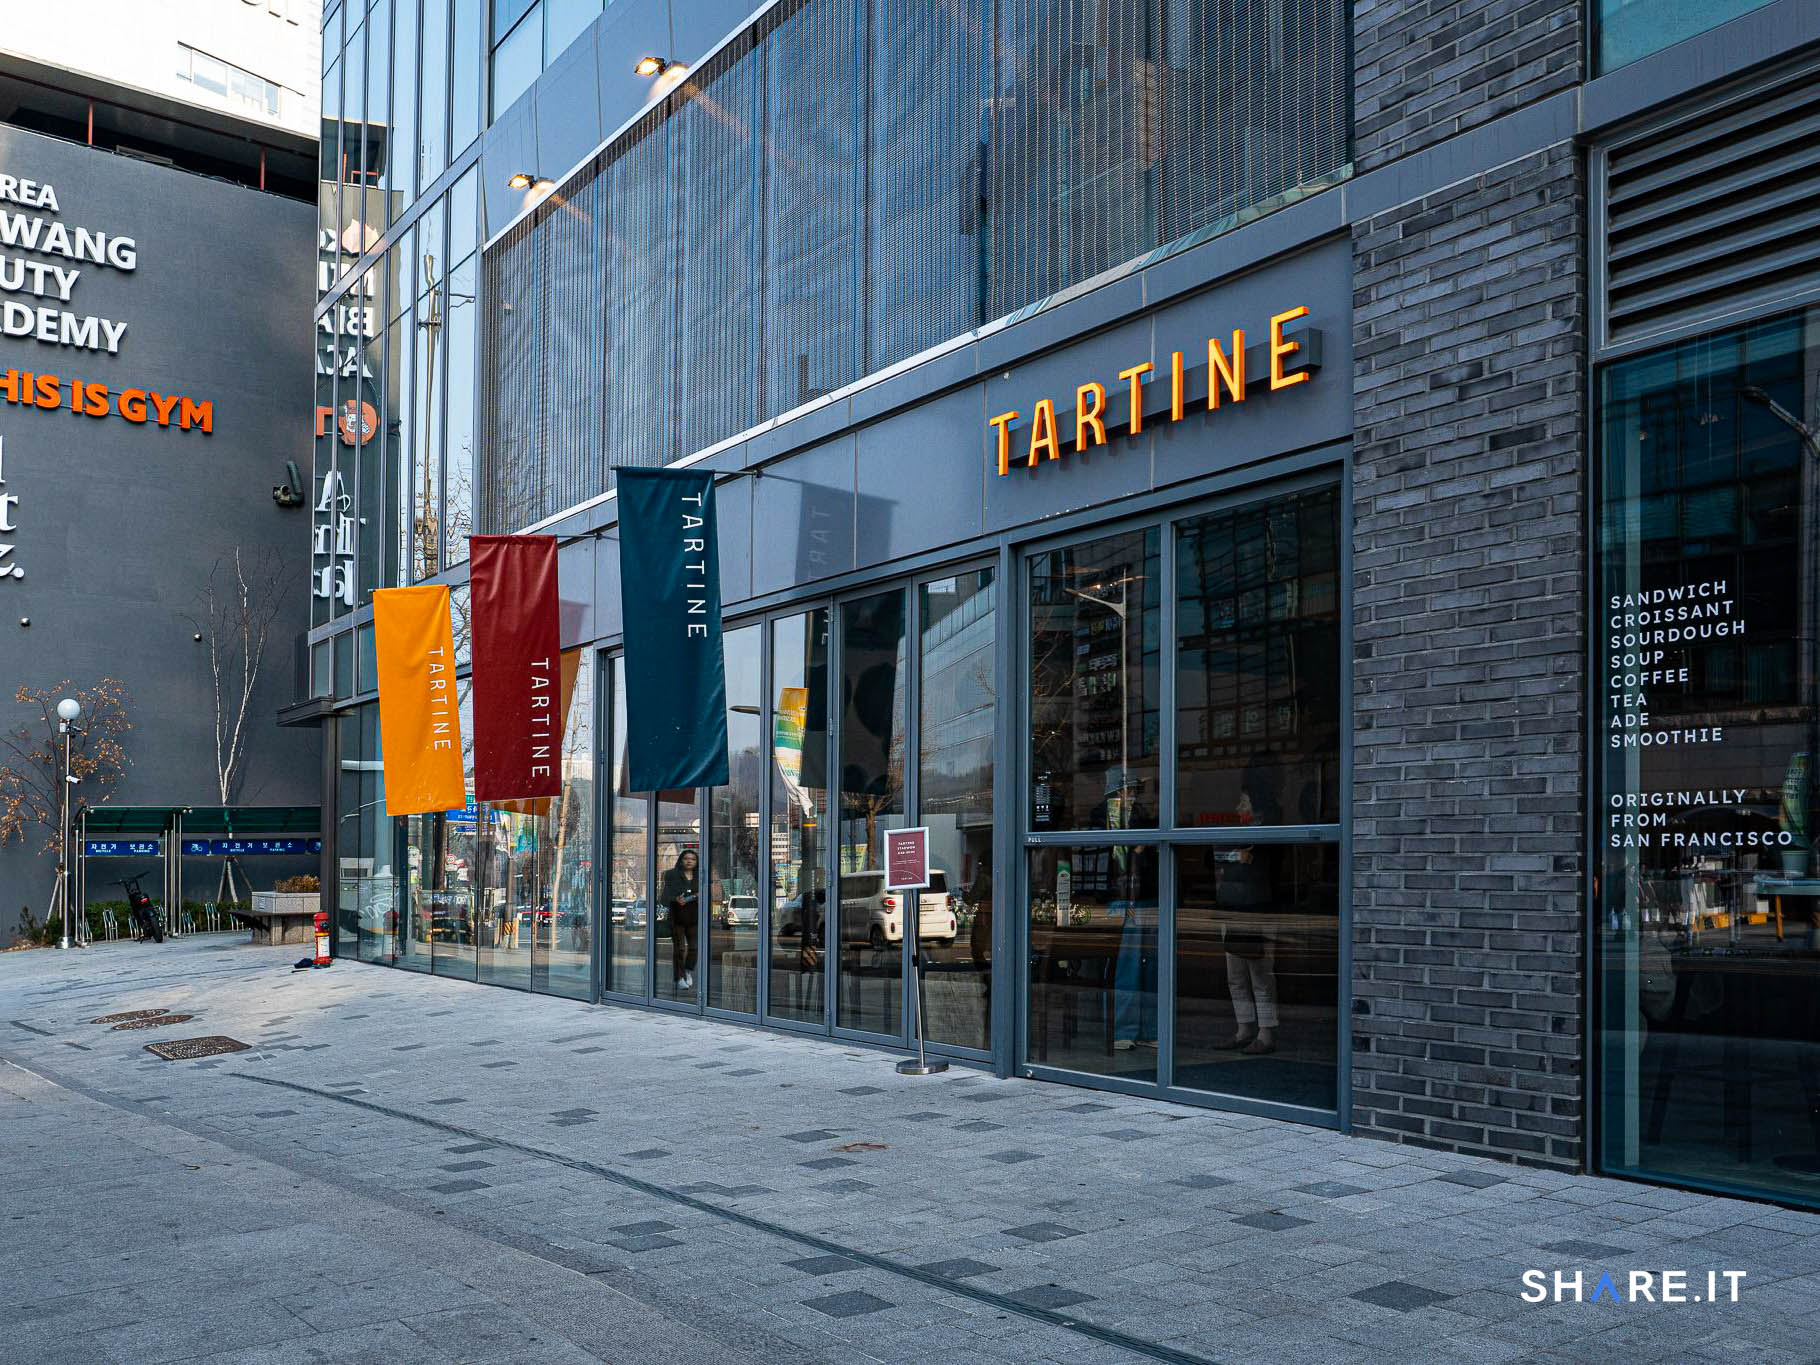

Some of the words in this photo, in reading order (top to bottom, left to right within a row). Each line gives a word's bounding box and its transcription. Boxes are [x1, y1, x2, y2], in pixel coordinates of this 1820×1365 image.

[0, 300, 128, 353] DEMY
[990, 305, 1310, 477] TARTINE
[72, 379, 110, 417] IS
[118, 388, 213, 433] GYM
[681, 492, 707, 639] TARTINE
[1611, 580, 1727, 609] SANDWICH
[1611, 600, 1734, 629] CROISSANT
[1611, 620, 1745, 649] SOURDOUGH
[1611, 650, 1664, 669] SOUP
[1611, 668, 1689, 688] COFFEE
[427, 646, 451, 751] TARTINE
[1611, 692, 1647, 708] TEA
[530, 657, 550, 778] TARTINE
[1611, 712, 1649, 728] ADE
[1611, 727, 1723, 748] SMOOTHIE
[1611, 789, 1747, 808] ORIGINALLY
[1611, 813, 1666, 827] FROM
[1611, 833, 1649, 847] SAN
[1661, 831, 1792, 847] FRANCISCO
